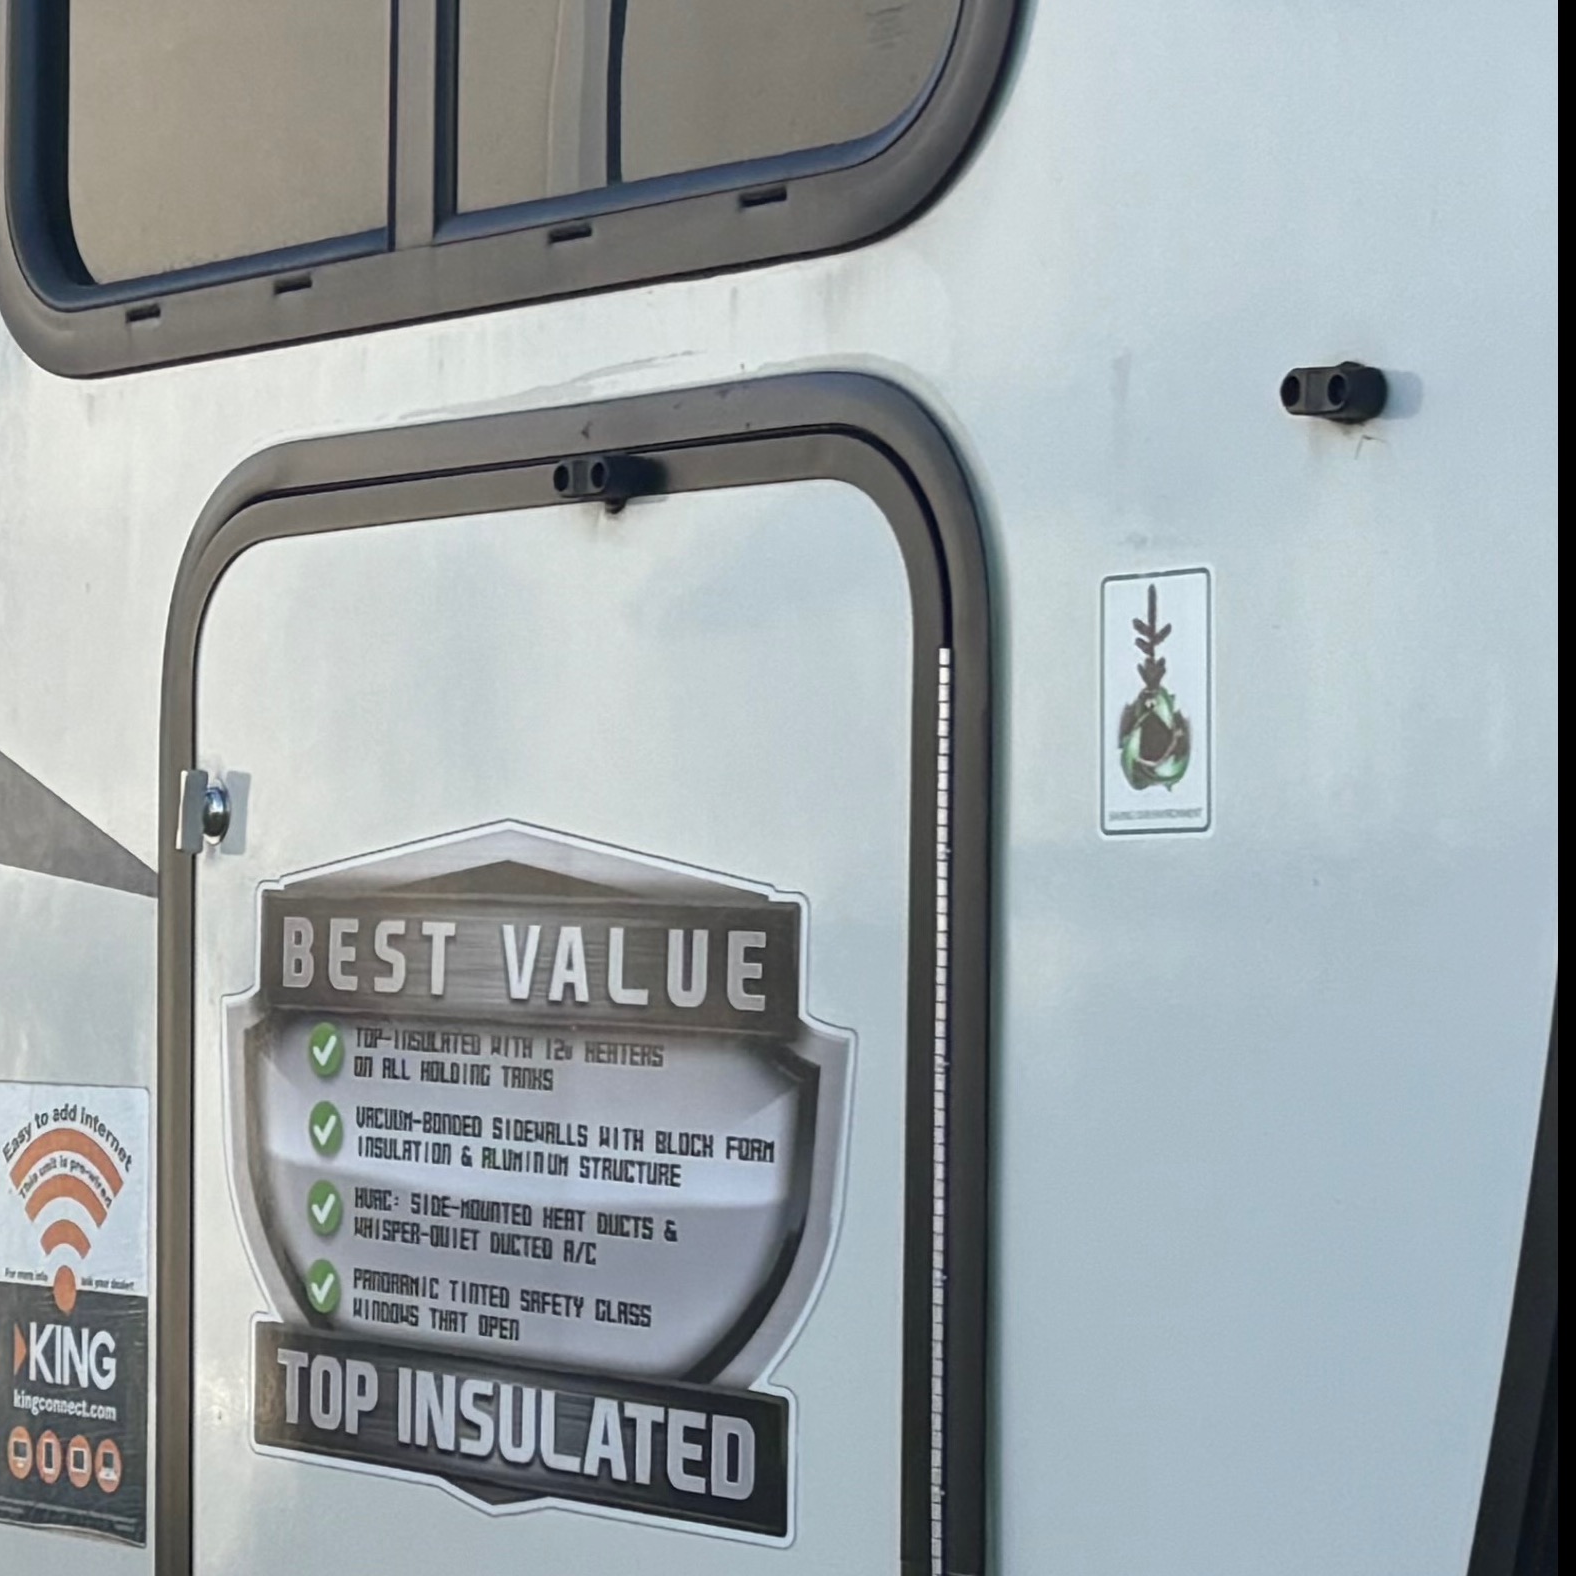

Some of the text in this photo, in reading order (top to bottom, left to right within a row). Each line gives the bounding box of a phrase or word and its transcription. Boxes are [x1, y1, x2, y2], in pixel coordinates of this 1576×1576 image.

[281, 915, 767, 1012] BEST VALUE
[356, 1027, 481, 1056] TOP-INSULATED
[490, 1035, 533, 1059] WITH
[584, 1040, 665, 1067] HEATERS
[353, 1056, 554, 1091] ON ALL HOLDING TANKS
[2, 1102, 132, 1173] Easy to add internet
[356, 1105, 483, 1138] VACUUM-BONDED
[492, 1116, 588, 1148] SIDEWALLS
[599, 1125, 644, 1152] WITH
[655, 1130, 714, 1158] BLOCK
[18, 1172, 38, 1199] This
[59, 1155, 68, 1168] is
[358, 1135, 682, 1187] INSULATION & ALUMINUM STRUCTURE
[354, 1186, 678, 1242] HVAC: SIDE-MOUNTED HEAT DUCTS &
[354, 1216, 597, 1265] WHISPER-QUIET DUCTED A/C
[353, 1267, 652, 1327] PANORAMIC TINTED SAFETY GLASS
[353, 1297, 519, 1341] WINDOWS THAT OPEN
[29, 1321, 116, 1391] KING
[13, 1388, 117, 1422] kingconnect.com
[275, 1347, 757, 1502] TOP INSULATED
